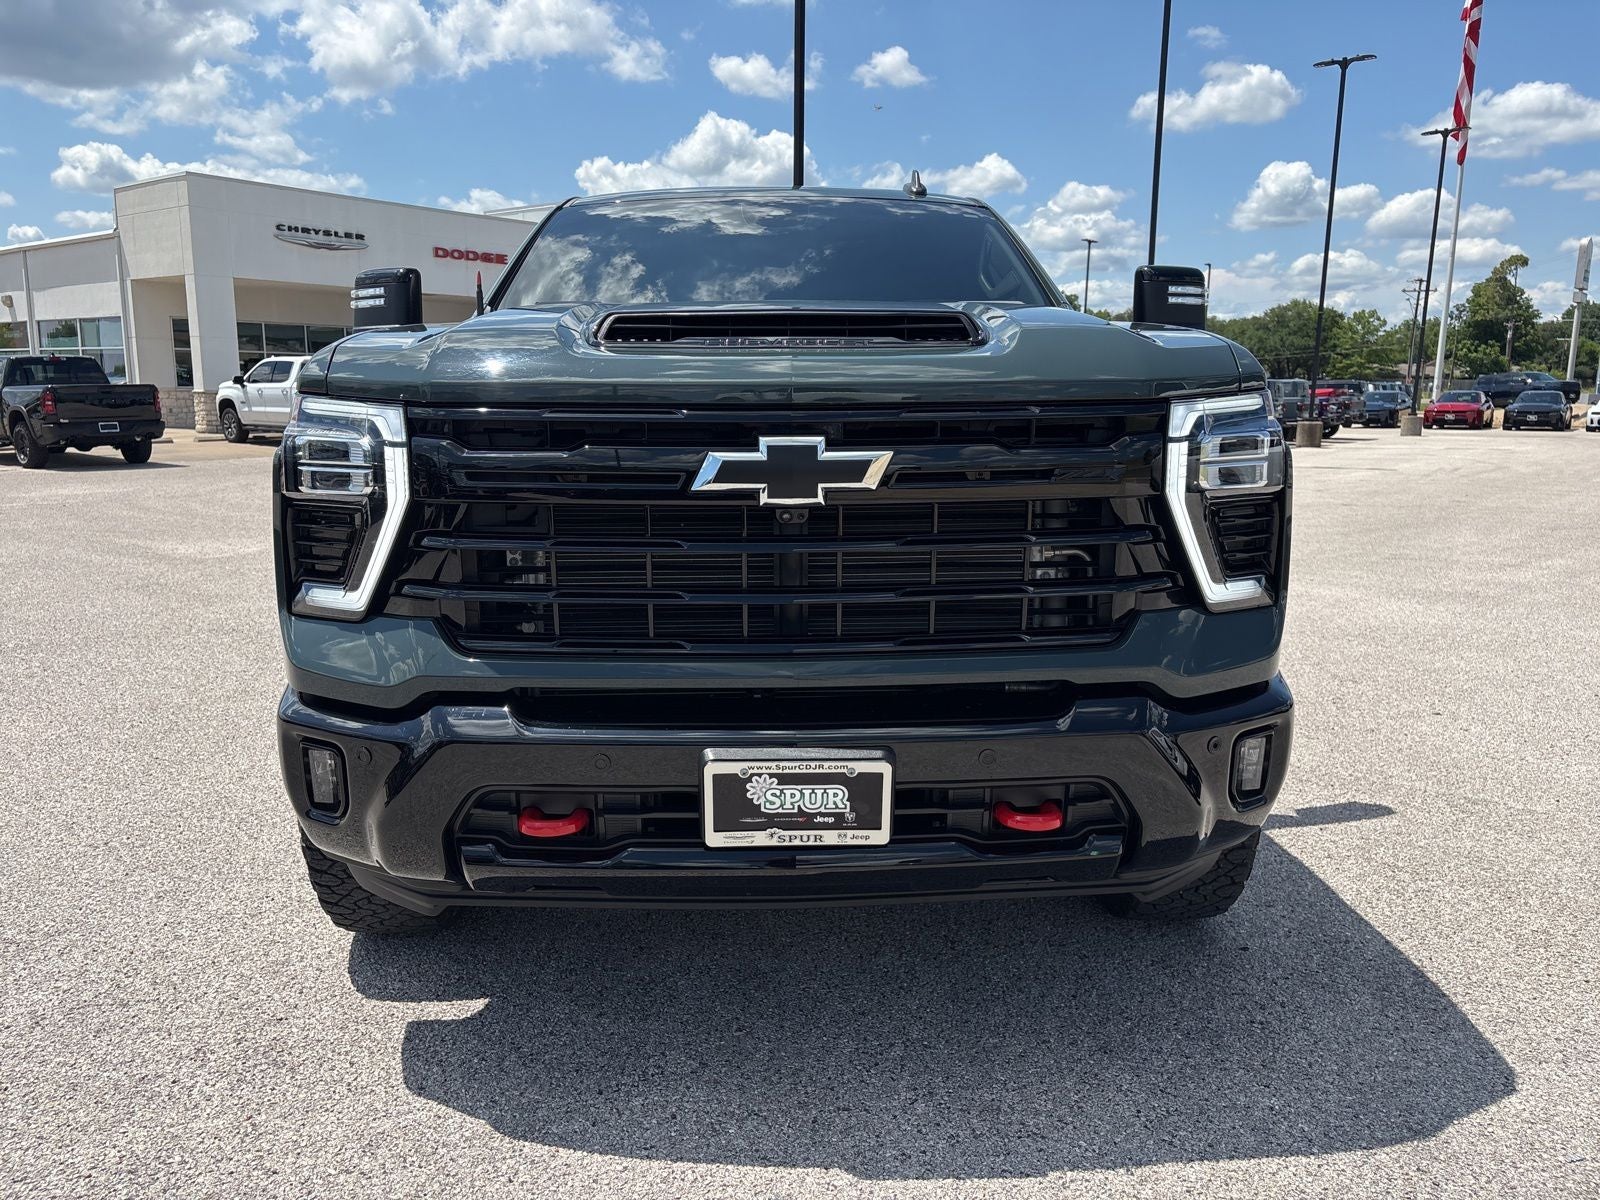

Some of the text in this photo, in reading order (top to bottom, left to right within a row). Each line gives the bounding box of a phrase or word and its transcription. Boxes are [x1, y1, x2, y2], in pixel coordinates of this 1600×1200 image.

[275, 223, 366, 241] CHRYSLER
[433, 246, 509, 265] DODGE
[747, 763, 849, 772] www.SpurCDJR.com
[763, 787, 848, 811] SPUR
[814, 816, 835, 824] Jeep
[777, 834, 825, 843] SPUR
[849, 834, 871, 842] Jeep
